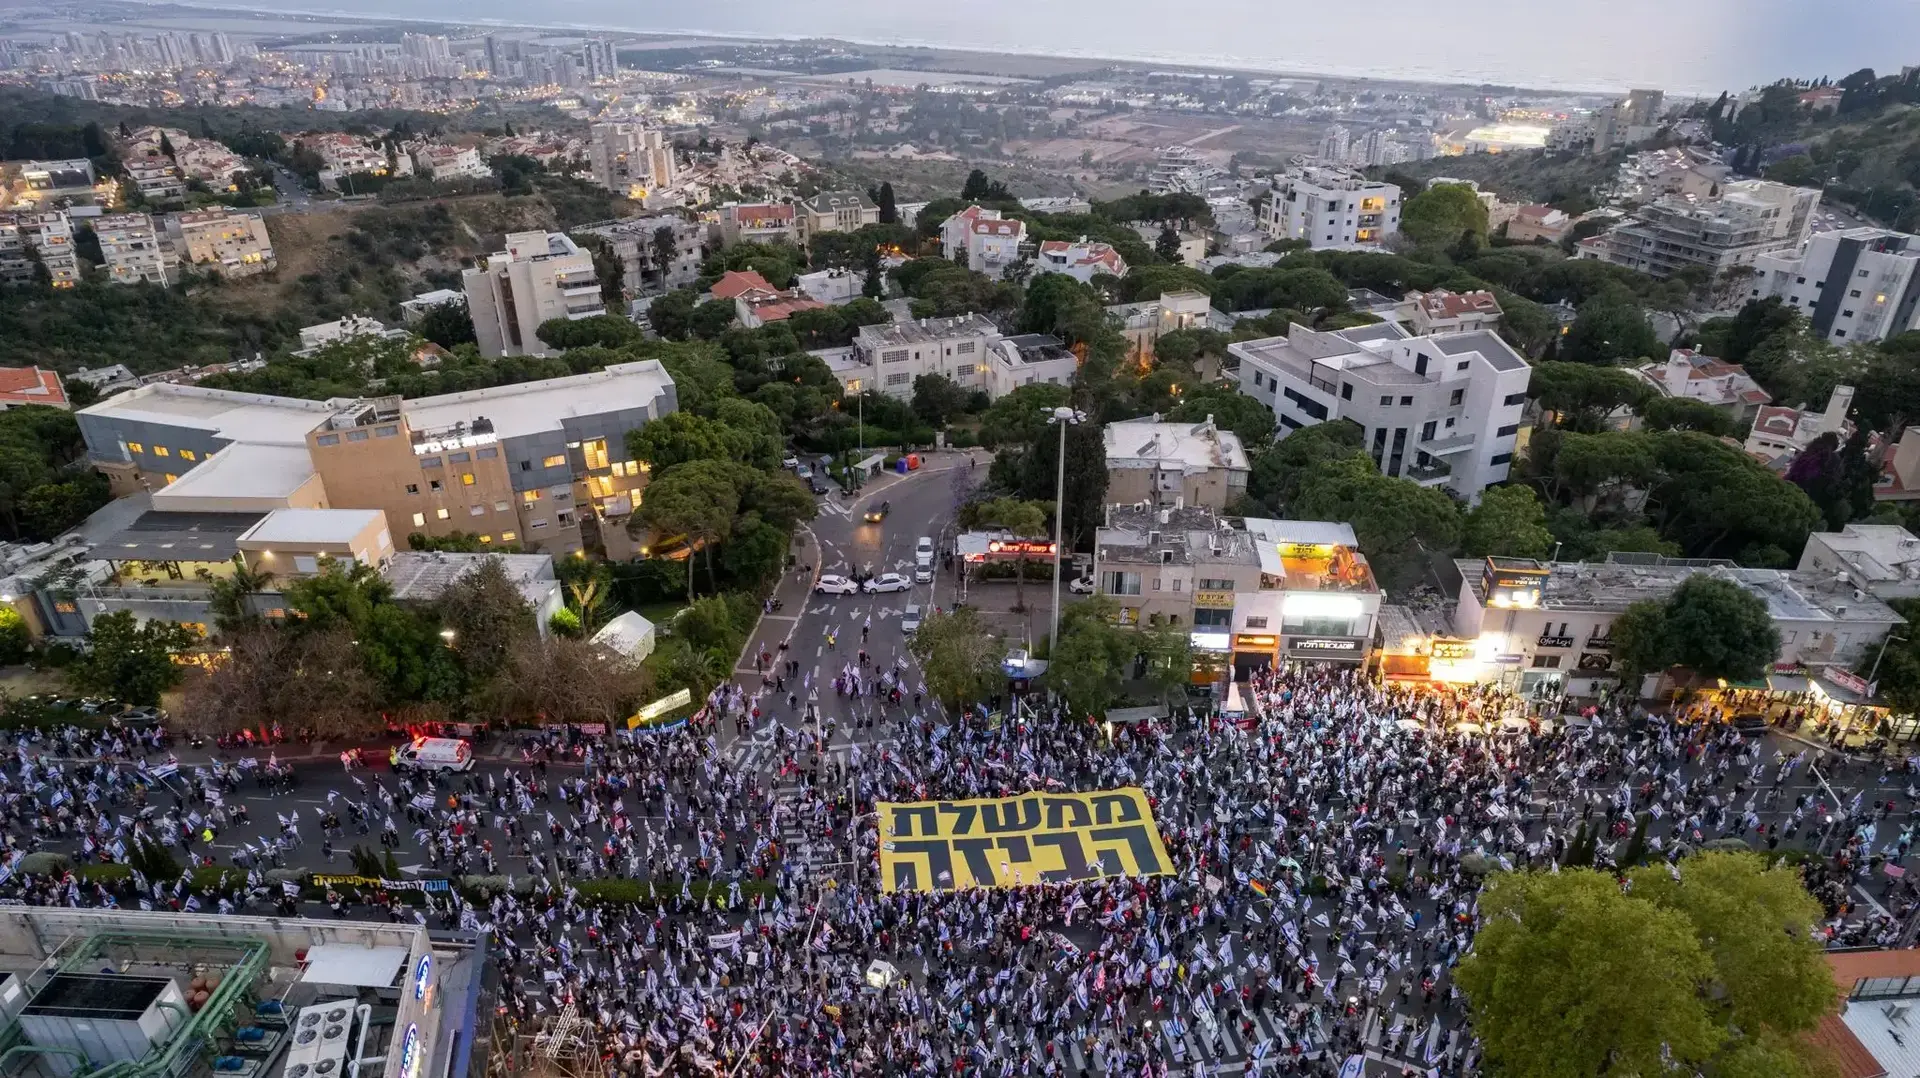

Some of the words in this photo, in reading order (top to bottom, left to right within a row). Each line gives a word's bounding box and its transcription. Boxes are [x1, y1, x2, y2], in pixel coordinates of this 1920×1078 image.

[1324, 642, 1355, 650] ROLADIN
[891, 795, 1142, 837] ממשלת
[892, 824, 1162, 889] הביזה
[424, 879, 449, 891] חובה
